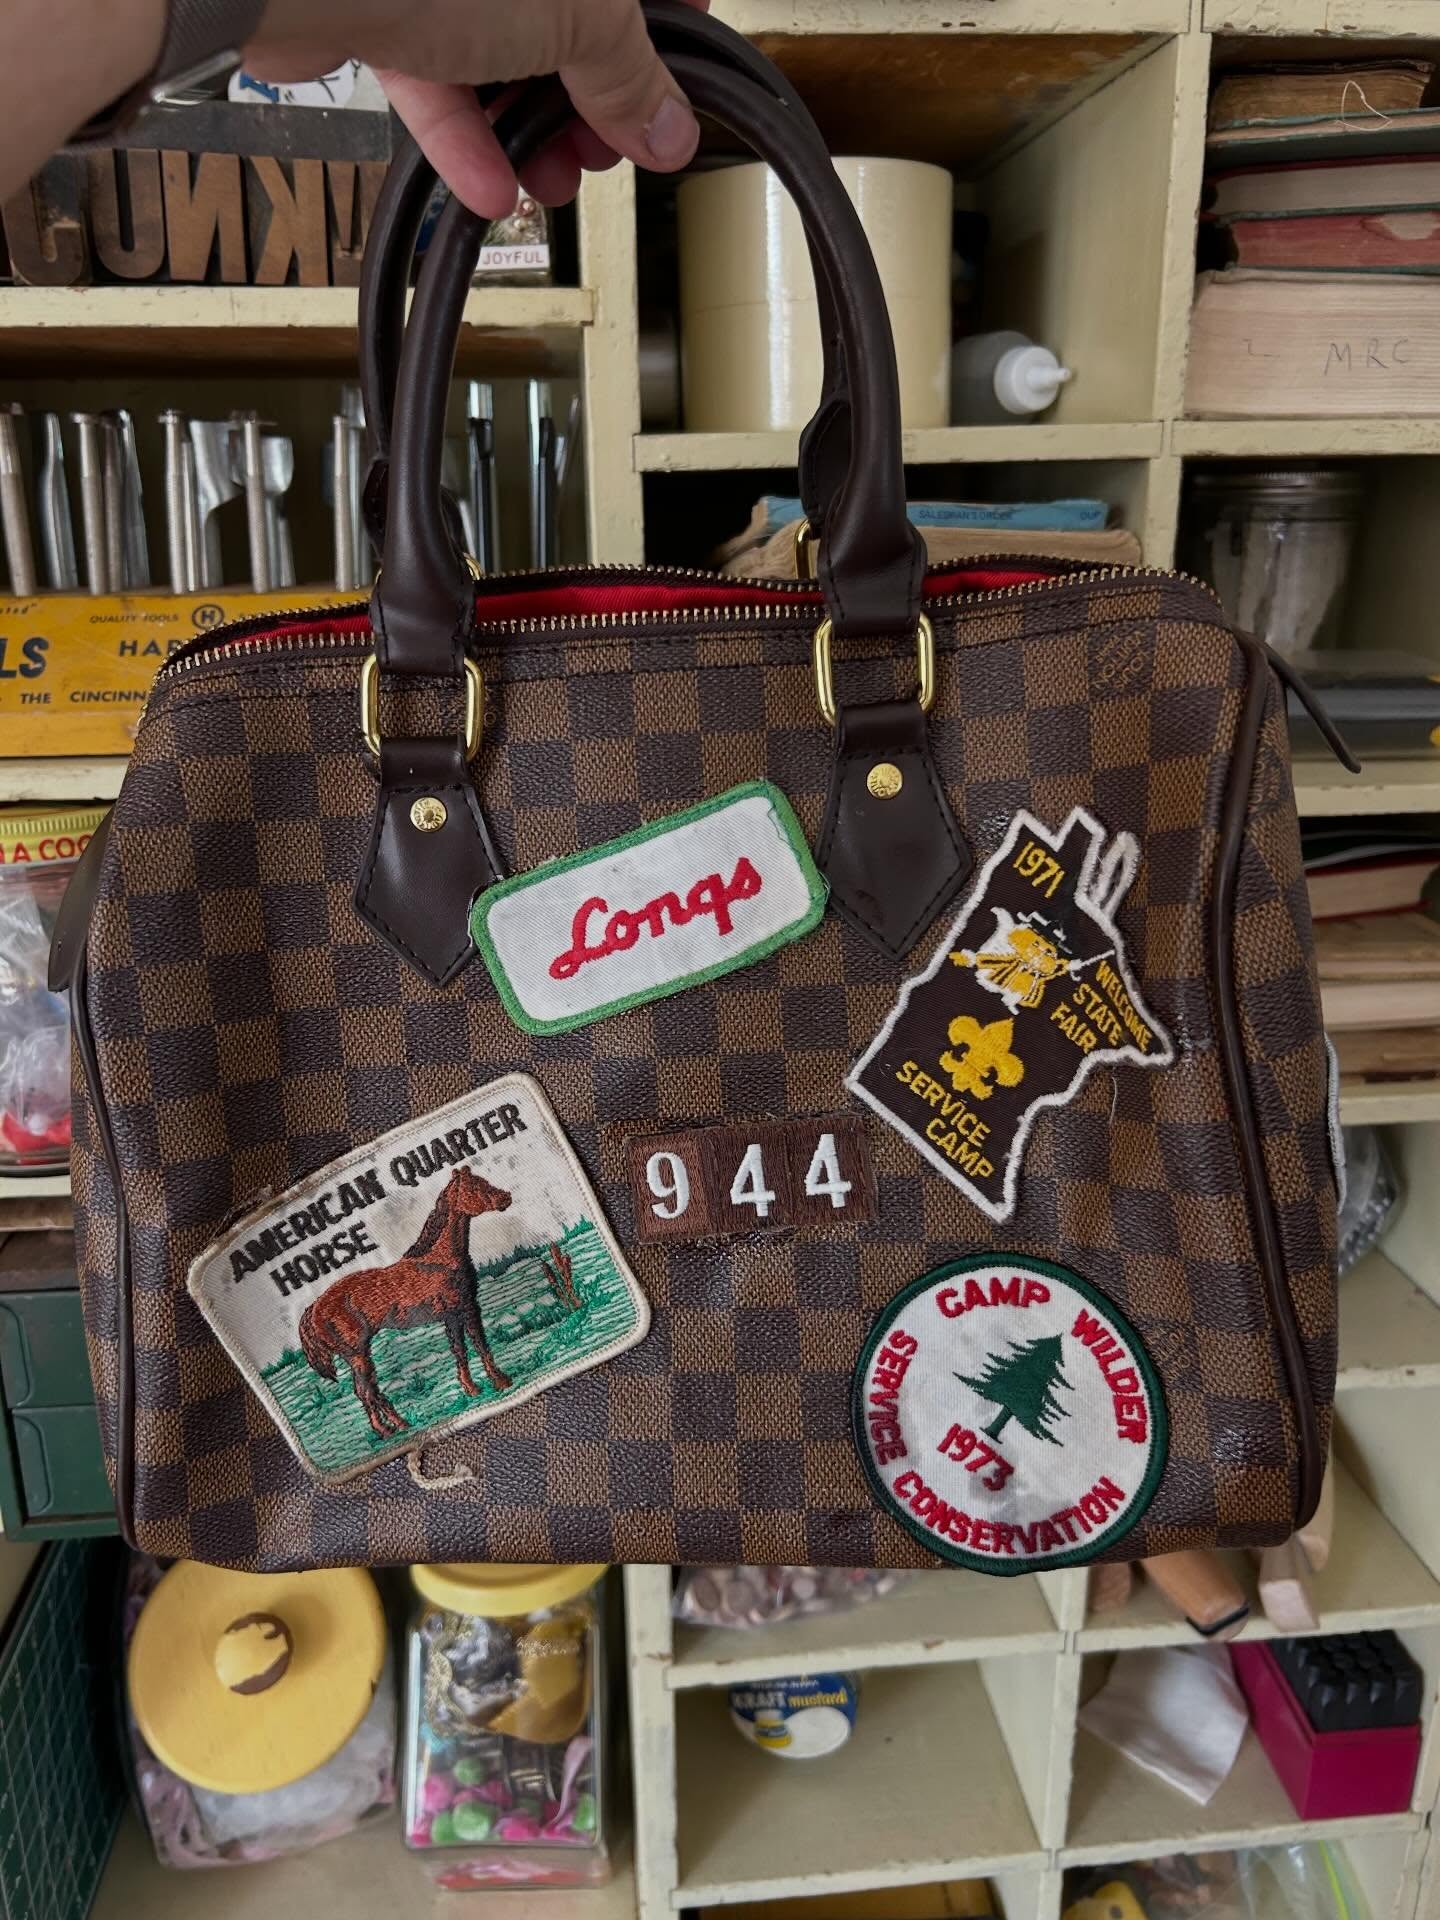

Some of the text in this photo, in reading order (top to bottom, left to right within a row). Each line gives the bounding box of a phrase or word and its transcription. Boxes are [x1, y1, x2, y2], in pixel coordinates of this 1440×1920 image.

[482, 251, 544, 265] JOYFUL
[89, 613, 179, 624] QUALITY TOOLS
[20, 692, 51, 704] THE
[1013, 840, 1065, 898] 1971
[1050, 1002, 1099, 1053] FAIR
[1072, 982, 1123, 1046] STATE
[895, 1060, 991, 1147] SERVICE
[925, 1117, 994, 1178] CAMP
[229, 1102, 528, 1283] AMERICAN QUARTER
[270, 1221, 378, 1297] HORSE
[935, 1276, 1051, 1319] CAMP
[1070, 1308, 1148, 1445] WILDER
[868, 1329, 1126, 1555] SERVICE CONSERVATION
[937, 1423, 1015, 1492] 1973
